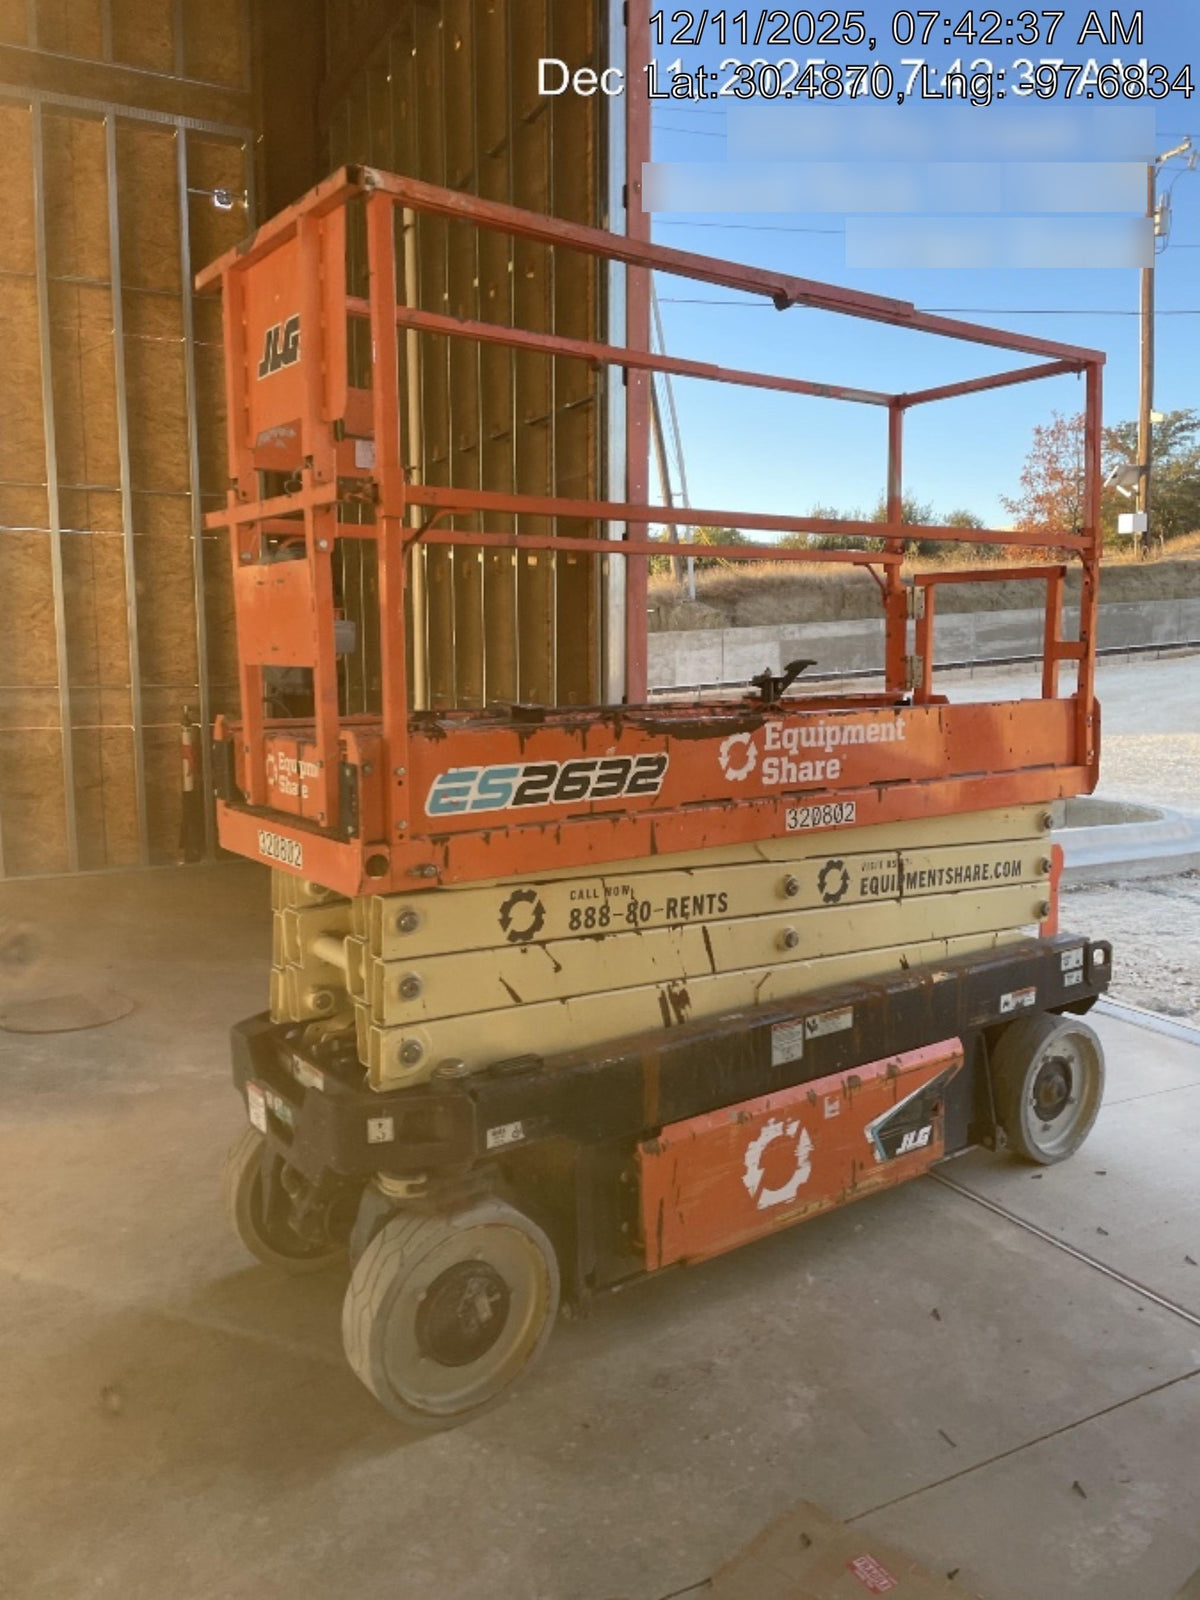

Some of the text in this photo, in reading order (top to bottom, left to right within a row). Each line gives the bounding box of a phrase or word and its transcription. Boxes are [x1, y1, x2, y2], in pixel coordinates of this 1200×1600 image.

[257, 312, 301, 381] JLG
[764, 718, 906, 755] Equipment
[425, 753, 669, 816] ES2632
[762, 756, 841, 785] Share
[786, 803, 855, 830] 320802
[570, 888, 600, 901] CALL
[569, 892, 728, 931] 888-80-RENTS
[896, 1125, 932, 1155] JLG
